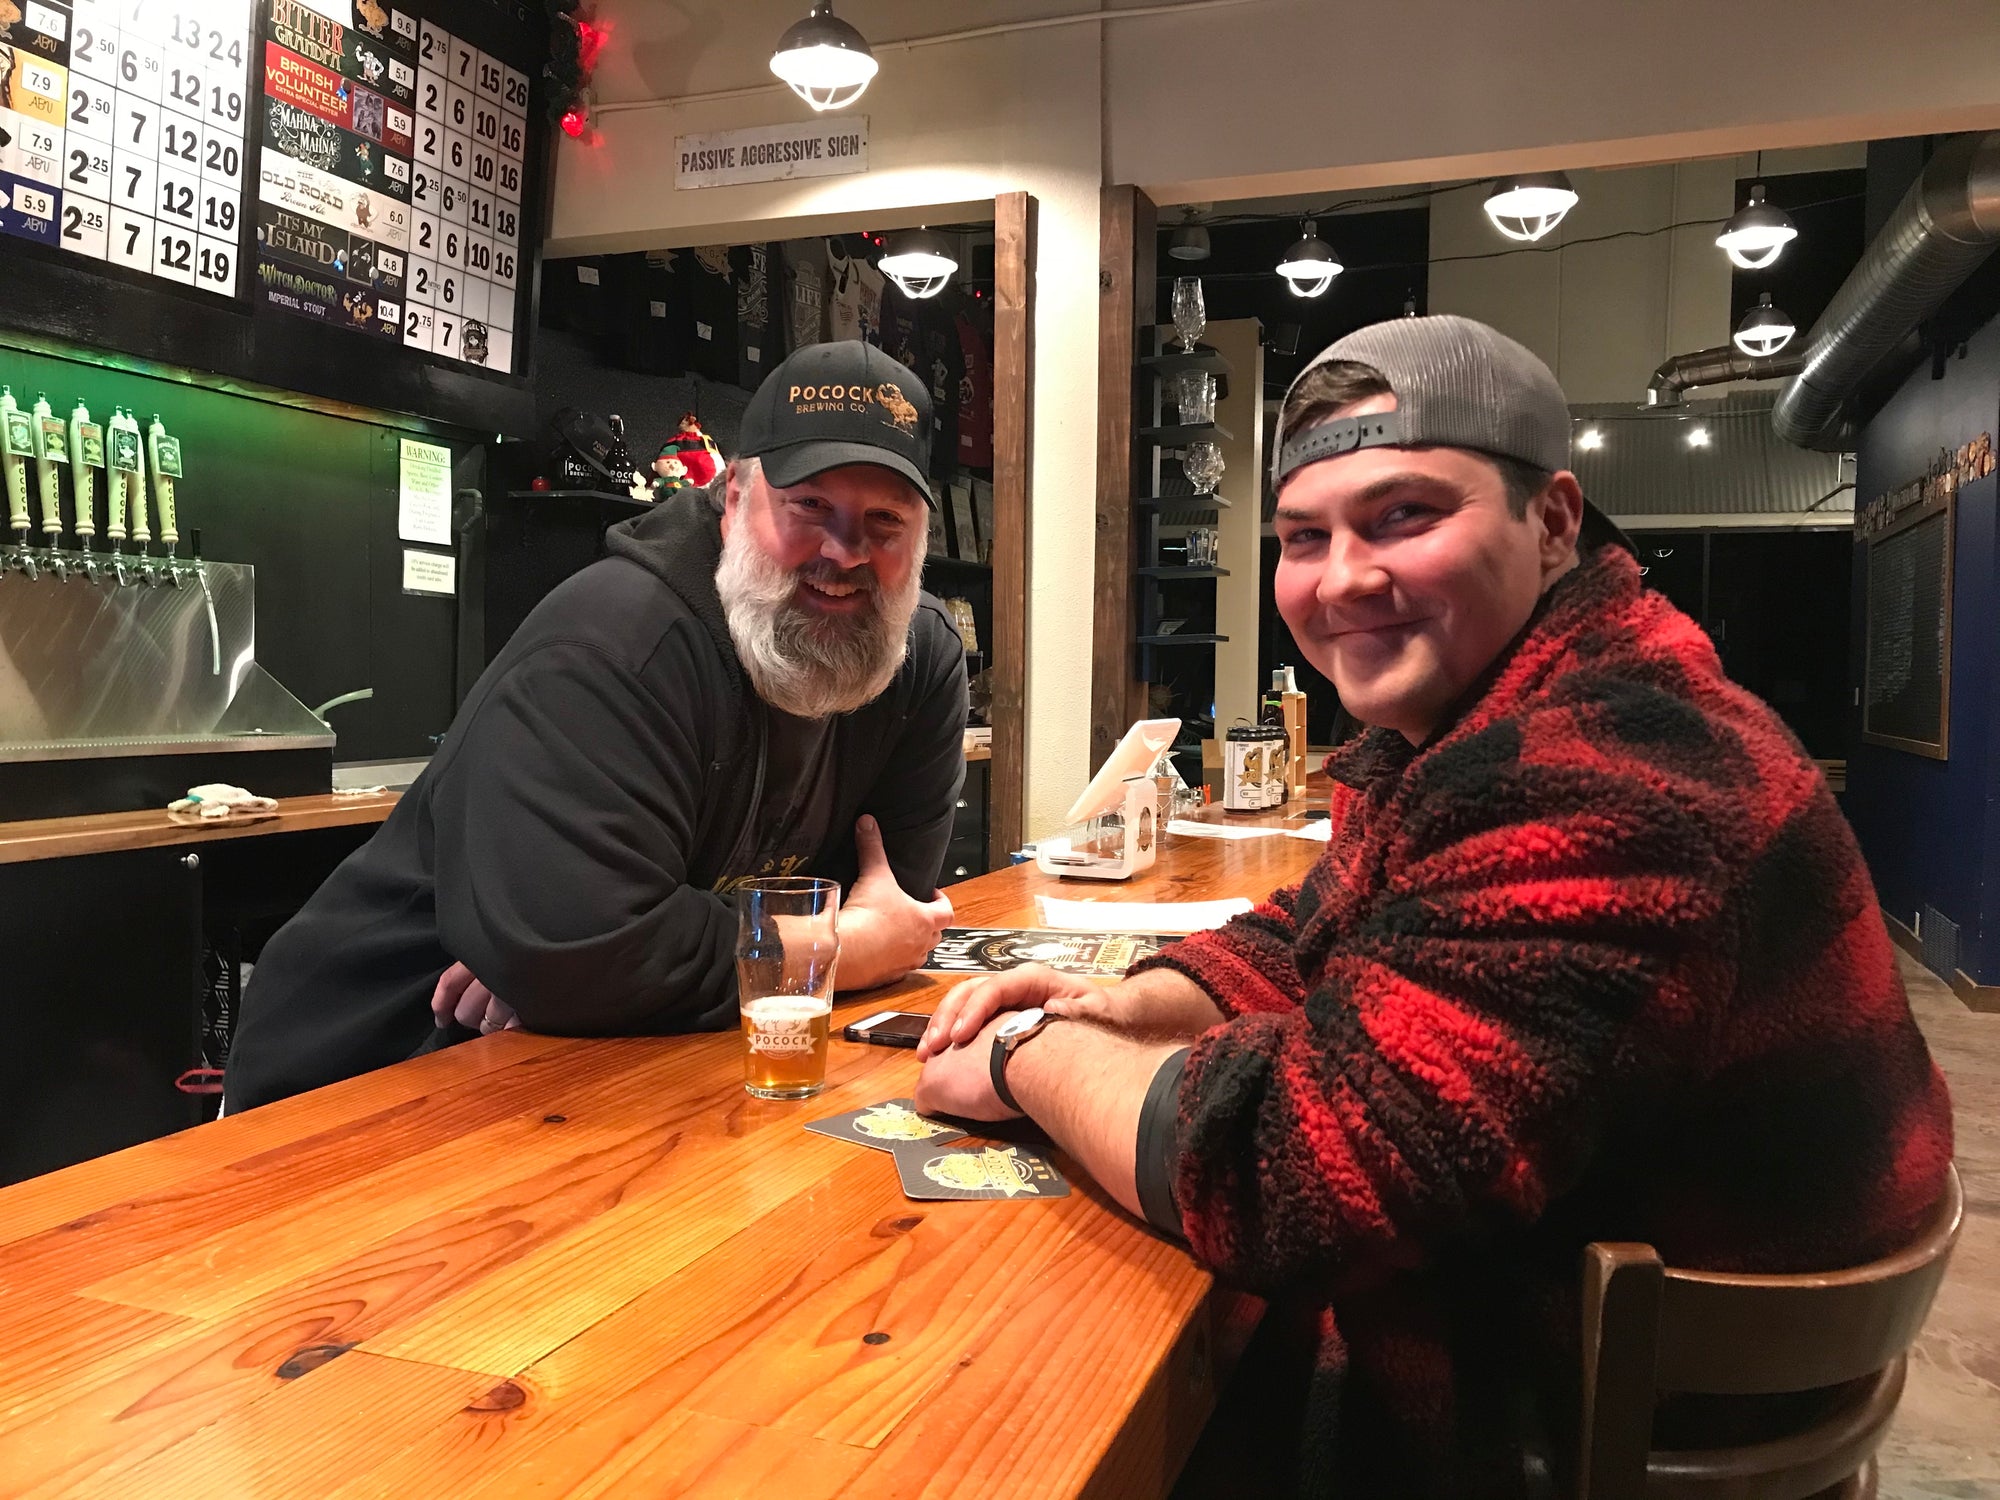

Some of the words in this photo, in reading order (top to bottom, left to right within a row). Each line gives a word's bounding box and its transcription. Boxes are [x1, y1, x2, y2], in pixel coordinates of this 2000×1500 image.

[38, 12, 58, 32] 7.6
[271, 0, 345, 57] BITTER
[397, 17, 412, 33] 9.6
[171, 13, 200, 48] 13
[208, 30, 242, 68] 24
[31, 72, 51, 91] 7.9
[280, 56, 333, 91] BRITISH
[394, 66, 407, 81] 5.1
[459, 50, 471, 77] 7
[481, 64, 500, 94] 15
[505, 77, 527, 107] 26
[170, 68, 200, 107] 12
[211, 86, 242, 122] 19
[266, 66, 348, 114] VOLUNTEER
[275, 85, 295, 98] EXTRA
[295, 93, 319, 109] SPECIAL
[319, 104, 339, 117] BITTER
[393, 115, 406, 131] 5.9
[426, 84, 437, 111] 2
[453, 99, 464, 124] 6
[476, 113, 496, 140] 10
[501, 124, 521, 152] 16
[31, 132, 53, 151] 7.9
[130, 111, 147, 143] 7
[165, 124, 197, 163] 12
[206, 139, 238, 177] 20
[681, 147, 735, 173] PASSIVE
[740, 138, 822, 167] AGGRESSIVE
[828, 134, 859, 157] SIGN
[391, 162, 404, 177] 7.6
[424, 127, 435, 155] 2
[452, 141, 463, 167] 6
[474, 155, 493, 182] 10
[500, 163, 518, 191] 16
[24, 194, 46, 213] 5.9
[125, 165, 142, 198] 7
[162, 181, 194, 219] 12
[205, 196, 235, 231] 19
[262, 170, 296, 190] OLD
[299, 182, 344, 210] ROAD
[301, 221, 325, 240] MY
[389, 210, 403, 225] 6.0
[471, 199, 490, 227] 11
[497, 208, 516, 237] 18
[124, 223, 141, 255] 7
[160, 236, 191, 272] 12
[199, 248, 229, 283] 19
[265, 223, 336, 265] ISLAND
[419, 222, 431, 249] 2
[446, 233, 457, 258] 6
[471, 243, 490, 270] 10
[495, 252, 514, 279] 16
[383, 257, 397, 272] 4.8
[416, 268, 428, 294] 2
[443, 279, 454, 303] 6
[268, 291, 300, 309] IMPERIAL
[303, 302, 326, 316] STOUT
[380, 306, 394, 319] 10.4
[442, 322, 453, 346] 7
[789, 384, 875, 404] POCOCK
[796, 402, 844, 415] BREWING
[406, 445, 446, 464] WARNING:
[756, 1034, 807, 1045] POCOCK
